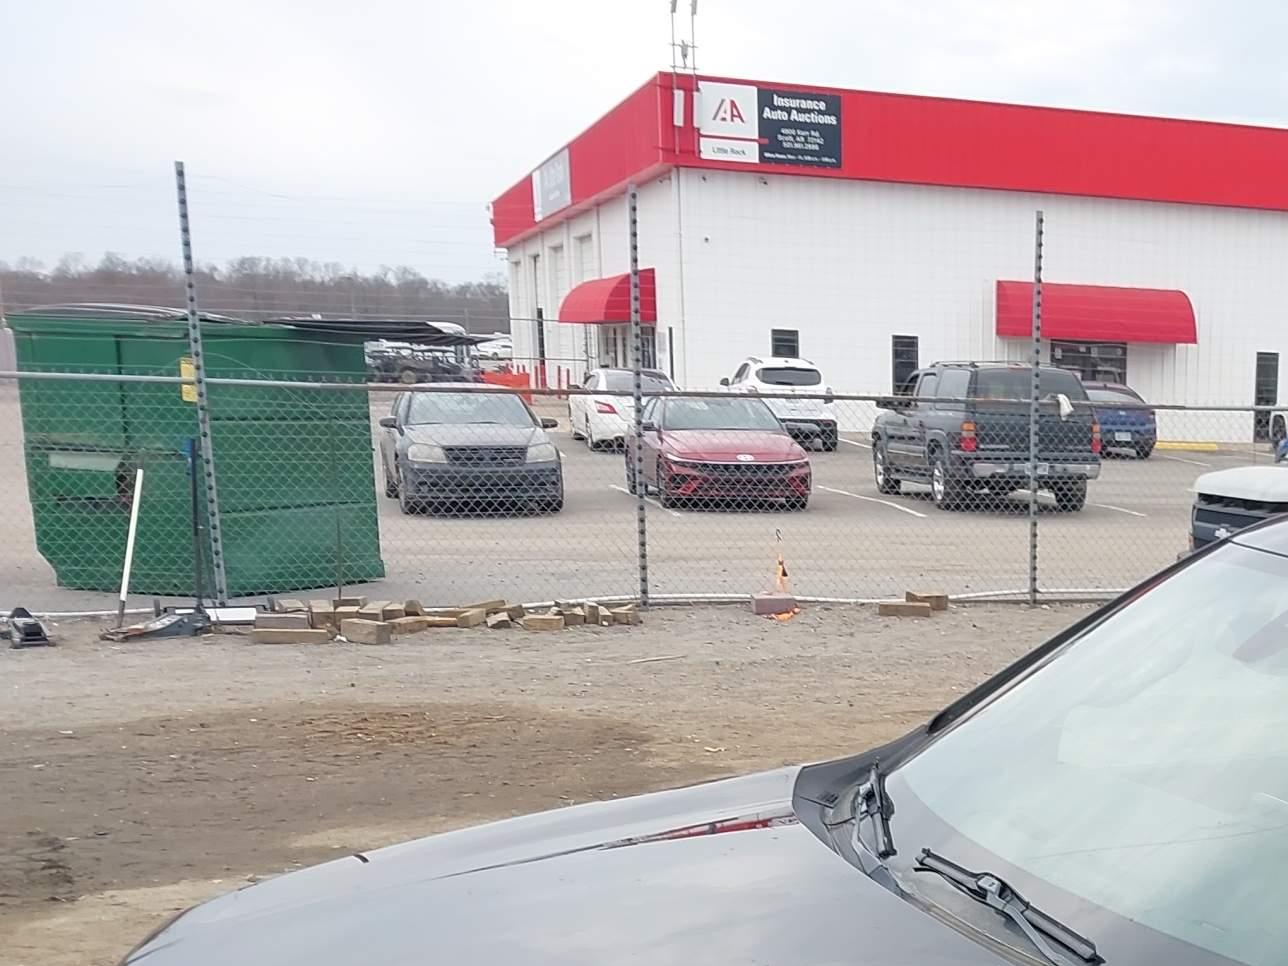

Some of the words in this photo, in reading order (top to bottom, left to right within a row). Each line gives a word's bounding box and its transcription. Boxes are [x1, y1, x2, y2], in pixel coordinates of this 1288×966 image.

[773, 94, 826, 110] Insurance
[762, 106, 789, 122] Auto
[790, 110, 838, 126] Auctions
[712, 146, 729, 155] Little
[729, 146, 747, 157] Rock
